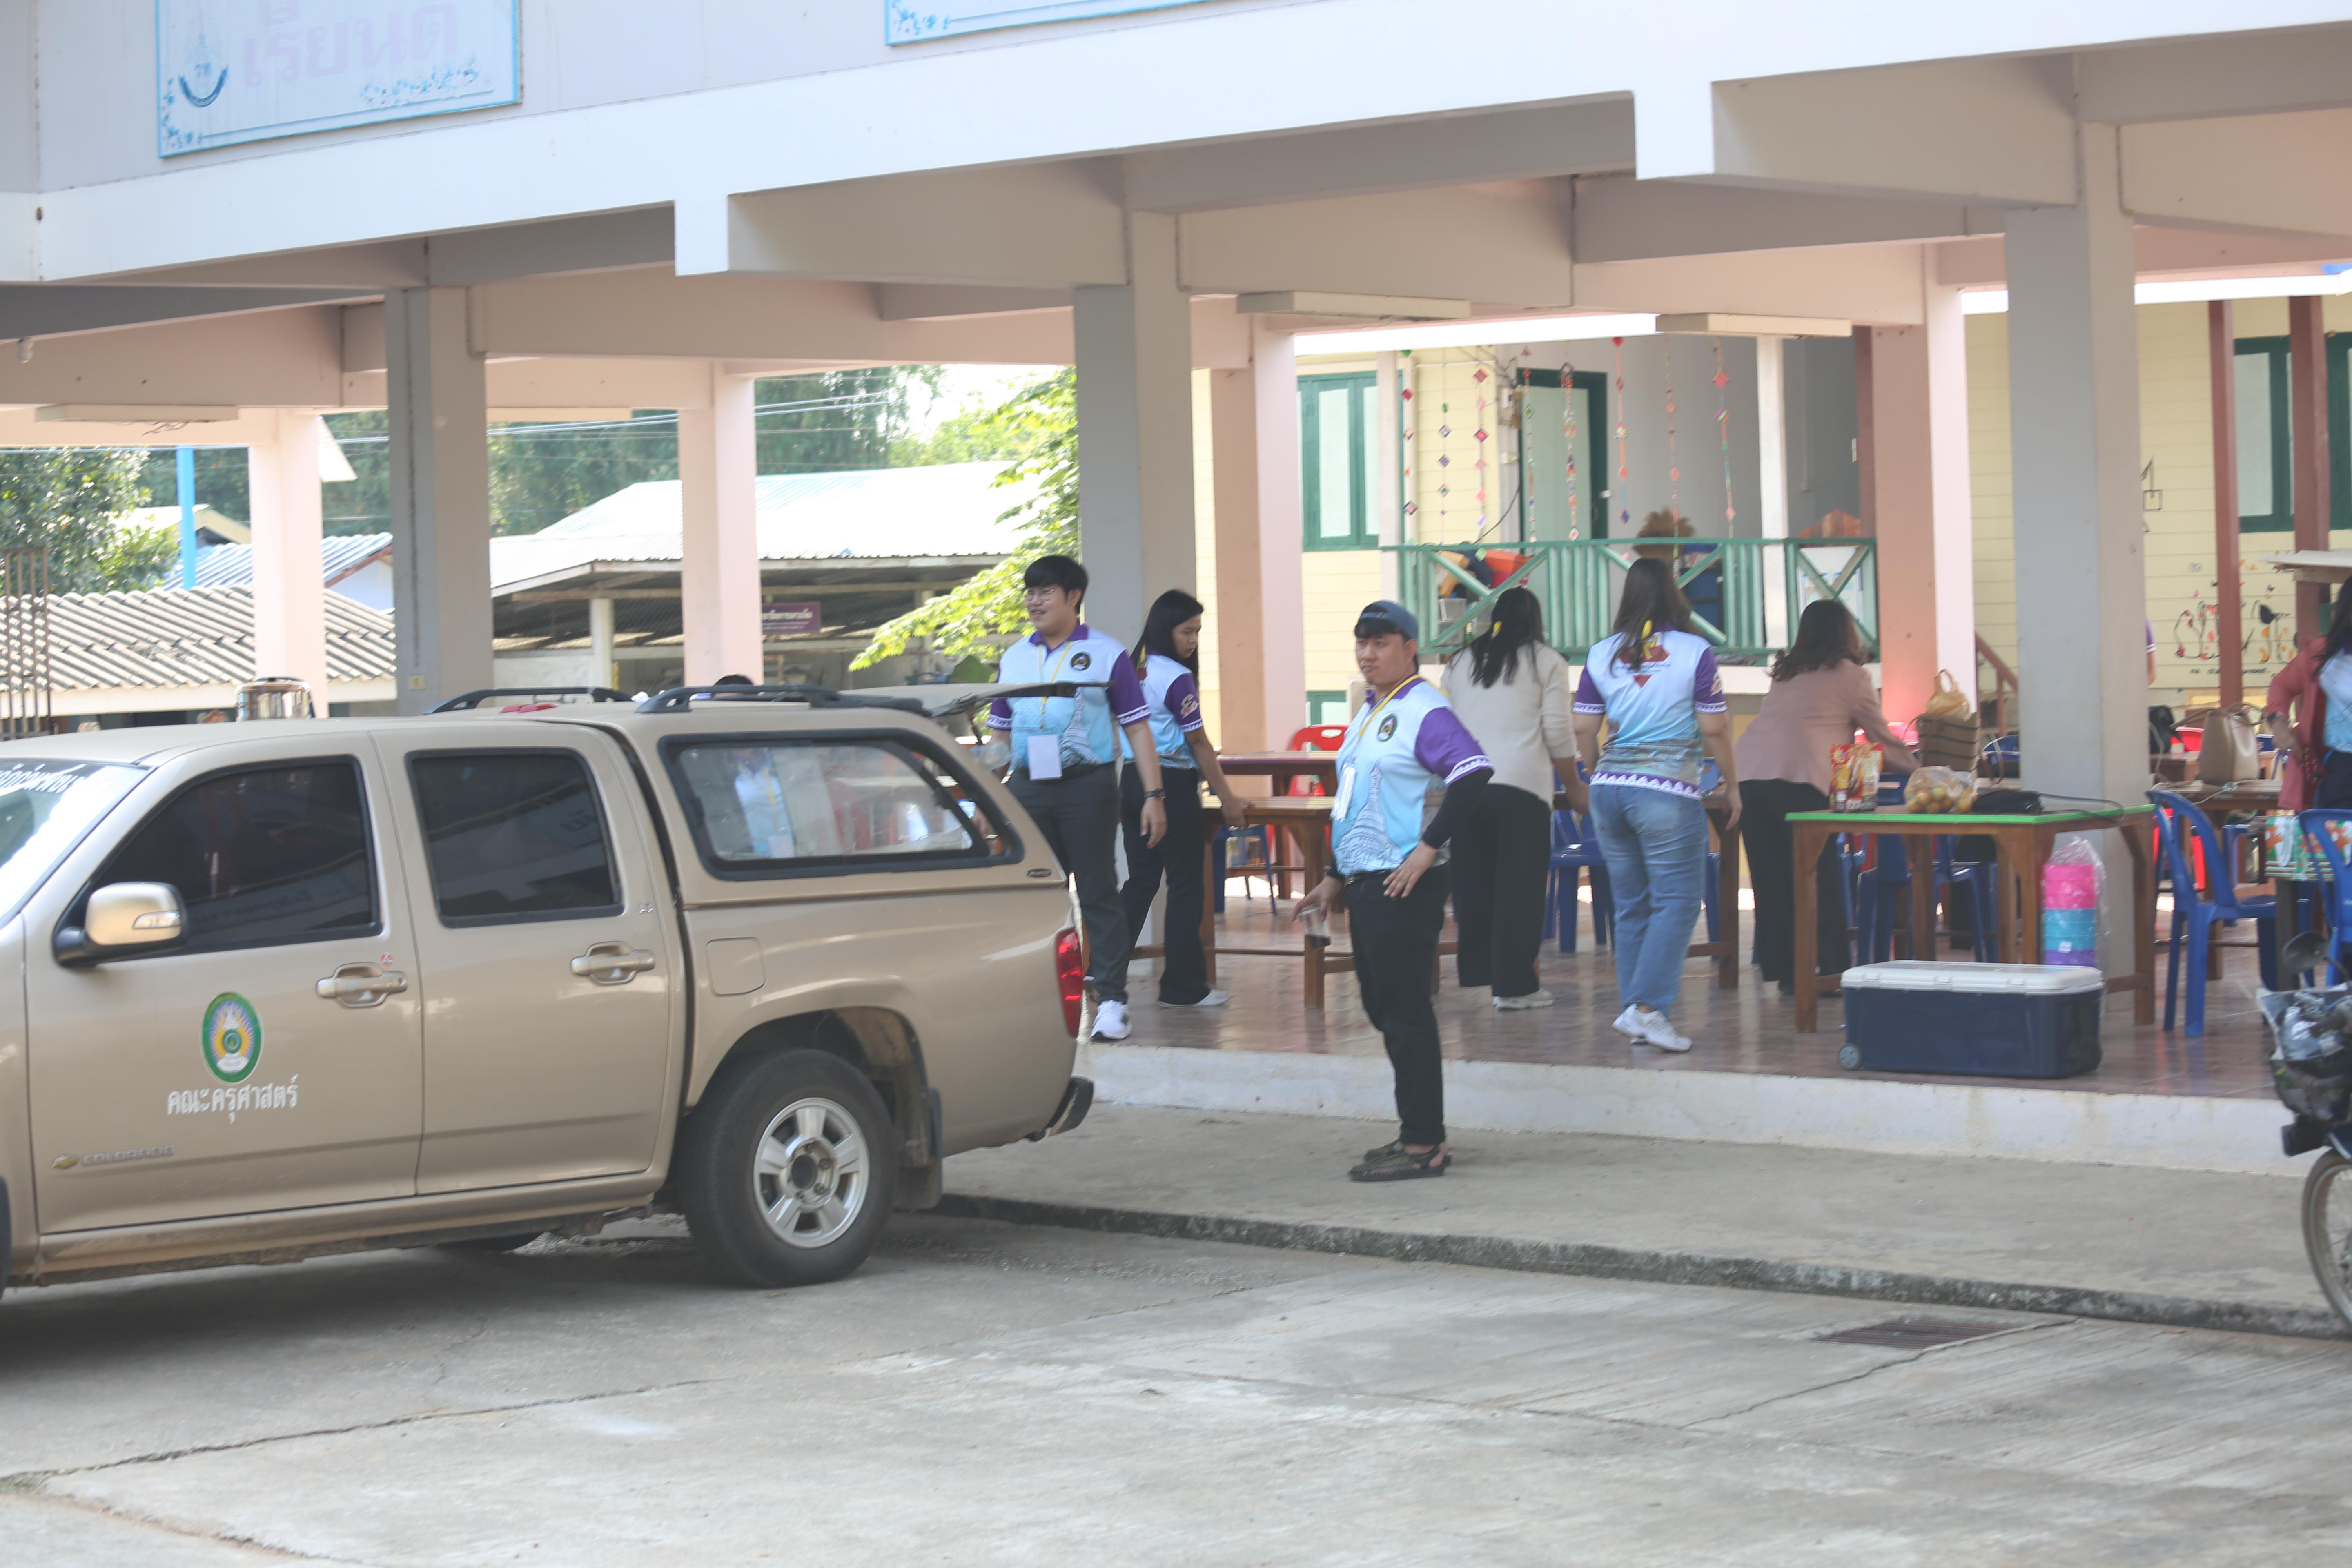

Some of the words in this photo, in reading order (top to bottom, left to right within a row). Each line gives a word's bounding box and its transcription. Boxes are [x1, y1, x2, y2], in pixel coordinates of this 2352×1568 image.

[167, 1074, 298, 1124] คณะครุศาสตร์
